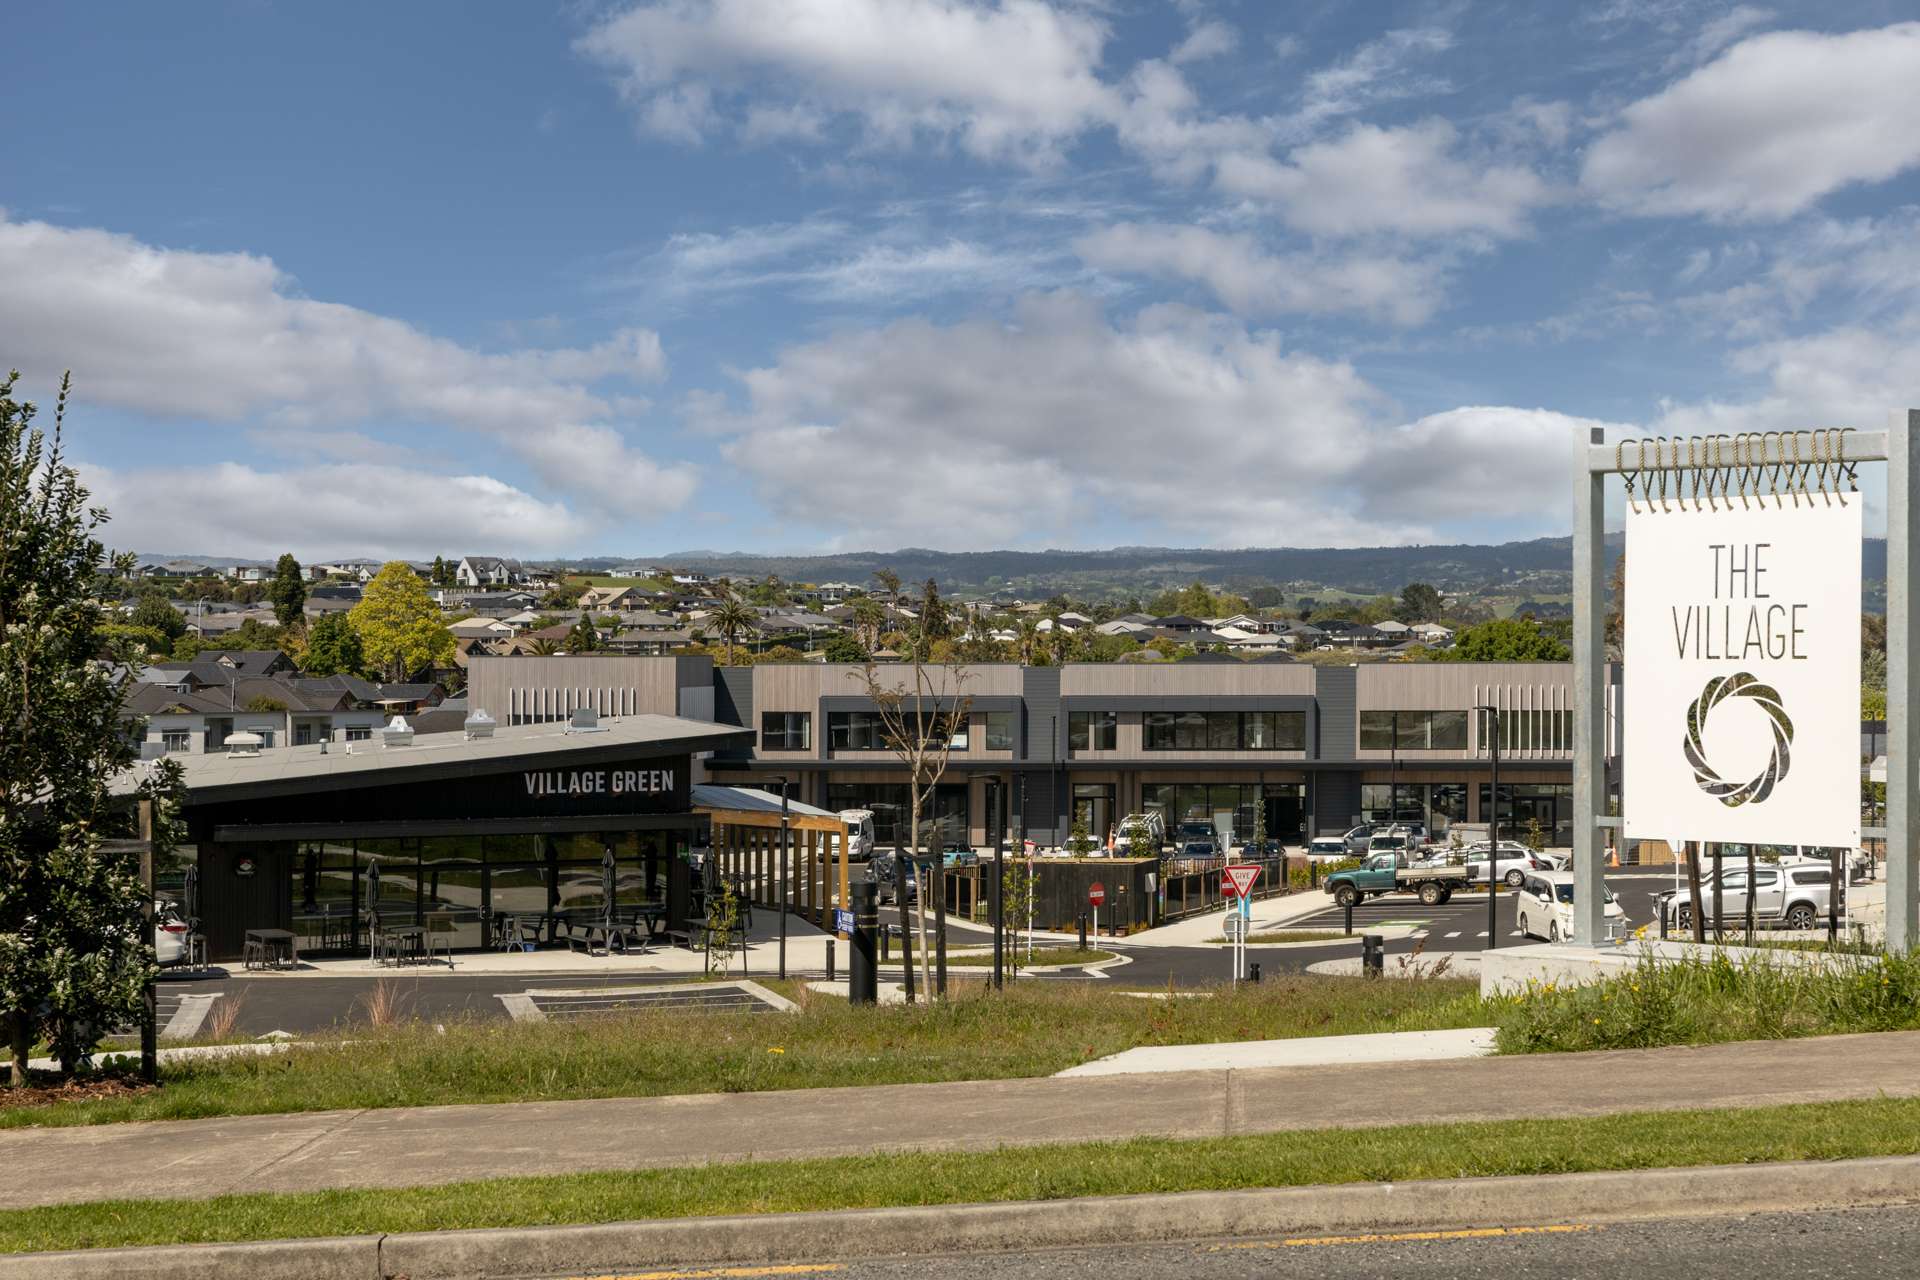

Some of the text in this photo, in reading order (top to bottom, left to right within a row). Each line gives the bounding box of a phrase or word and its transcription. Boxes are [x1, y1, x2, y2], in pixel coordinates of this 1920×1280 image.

[1708, 543, 1771, 599] THE
[1672, 604, 1808, 660] VILLAGE
[524, 770, 674, 795] VILLAGE GREEN
[1235, 872, 1250, 880] GIVE
